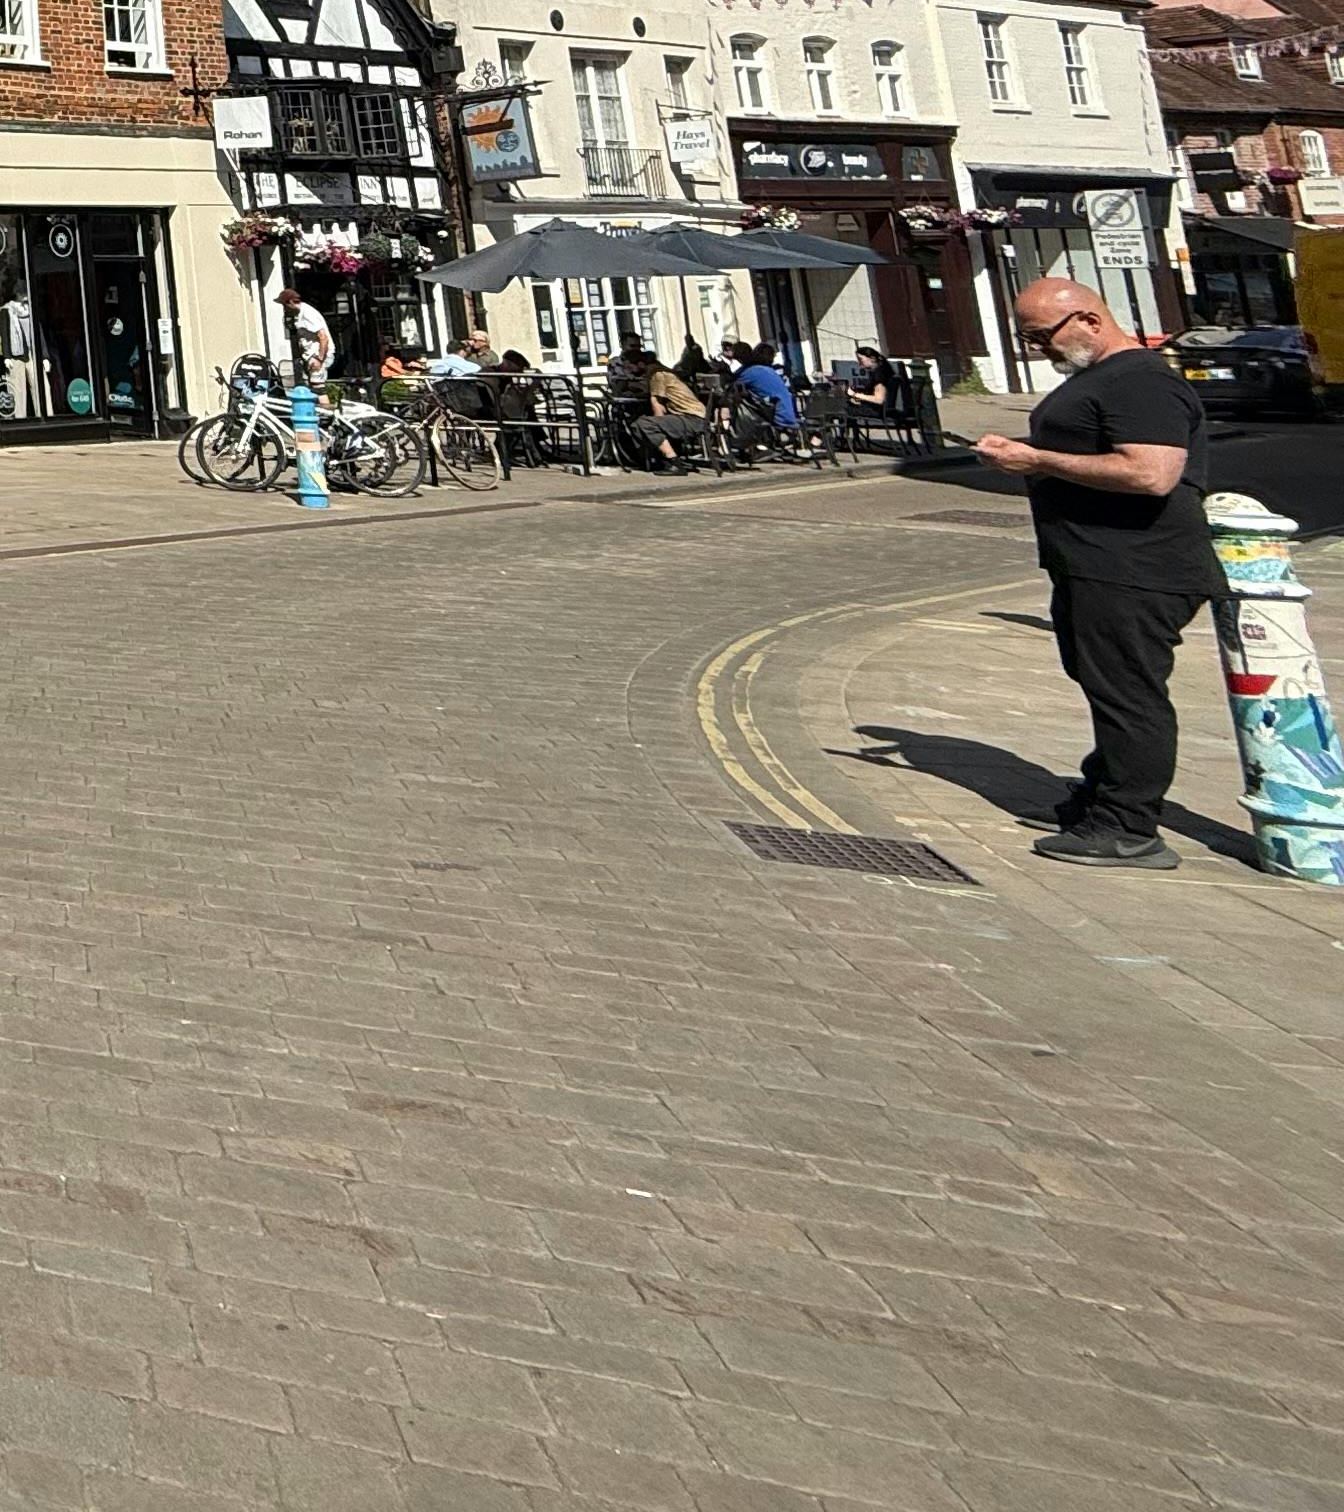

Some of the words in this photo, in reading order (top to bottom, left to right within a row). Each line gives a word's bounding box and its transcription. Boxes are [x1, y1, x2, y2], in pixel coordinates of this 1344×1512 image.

[223, 131, 263, 139] Rohan
[677, 131, 705, 140] Hays
[672, 139, 710, 150] Travel
[1102, 256, 1144, 264] ENDS
